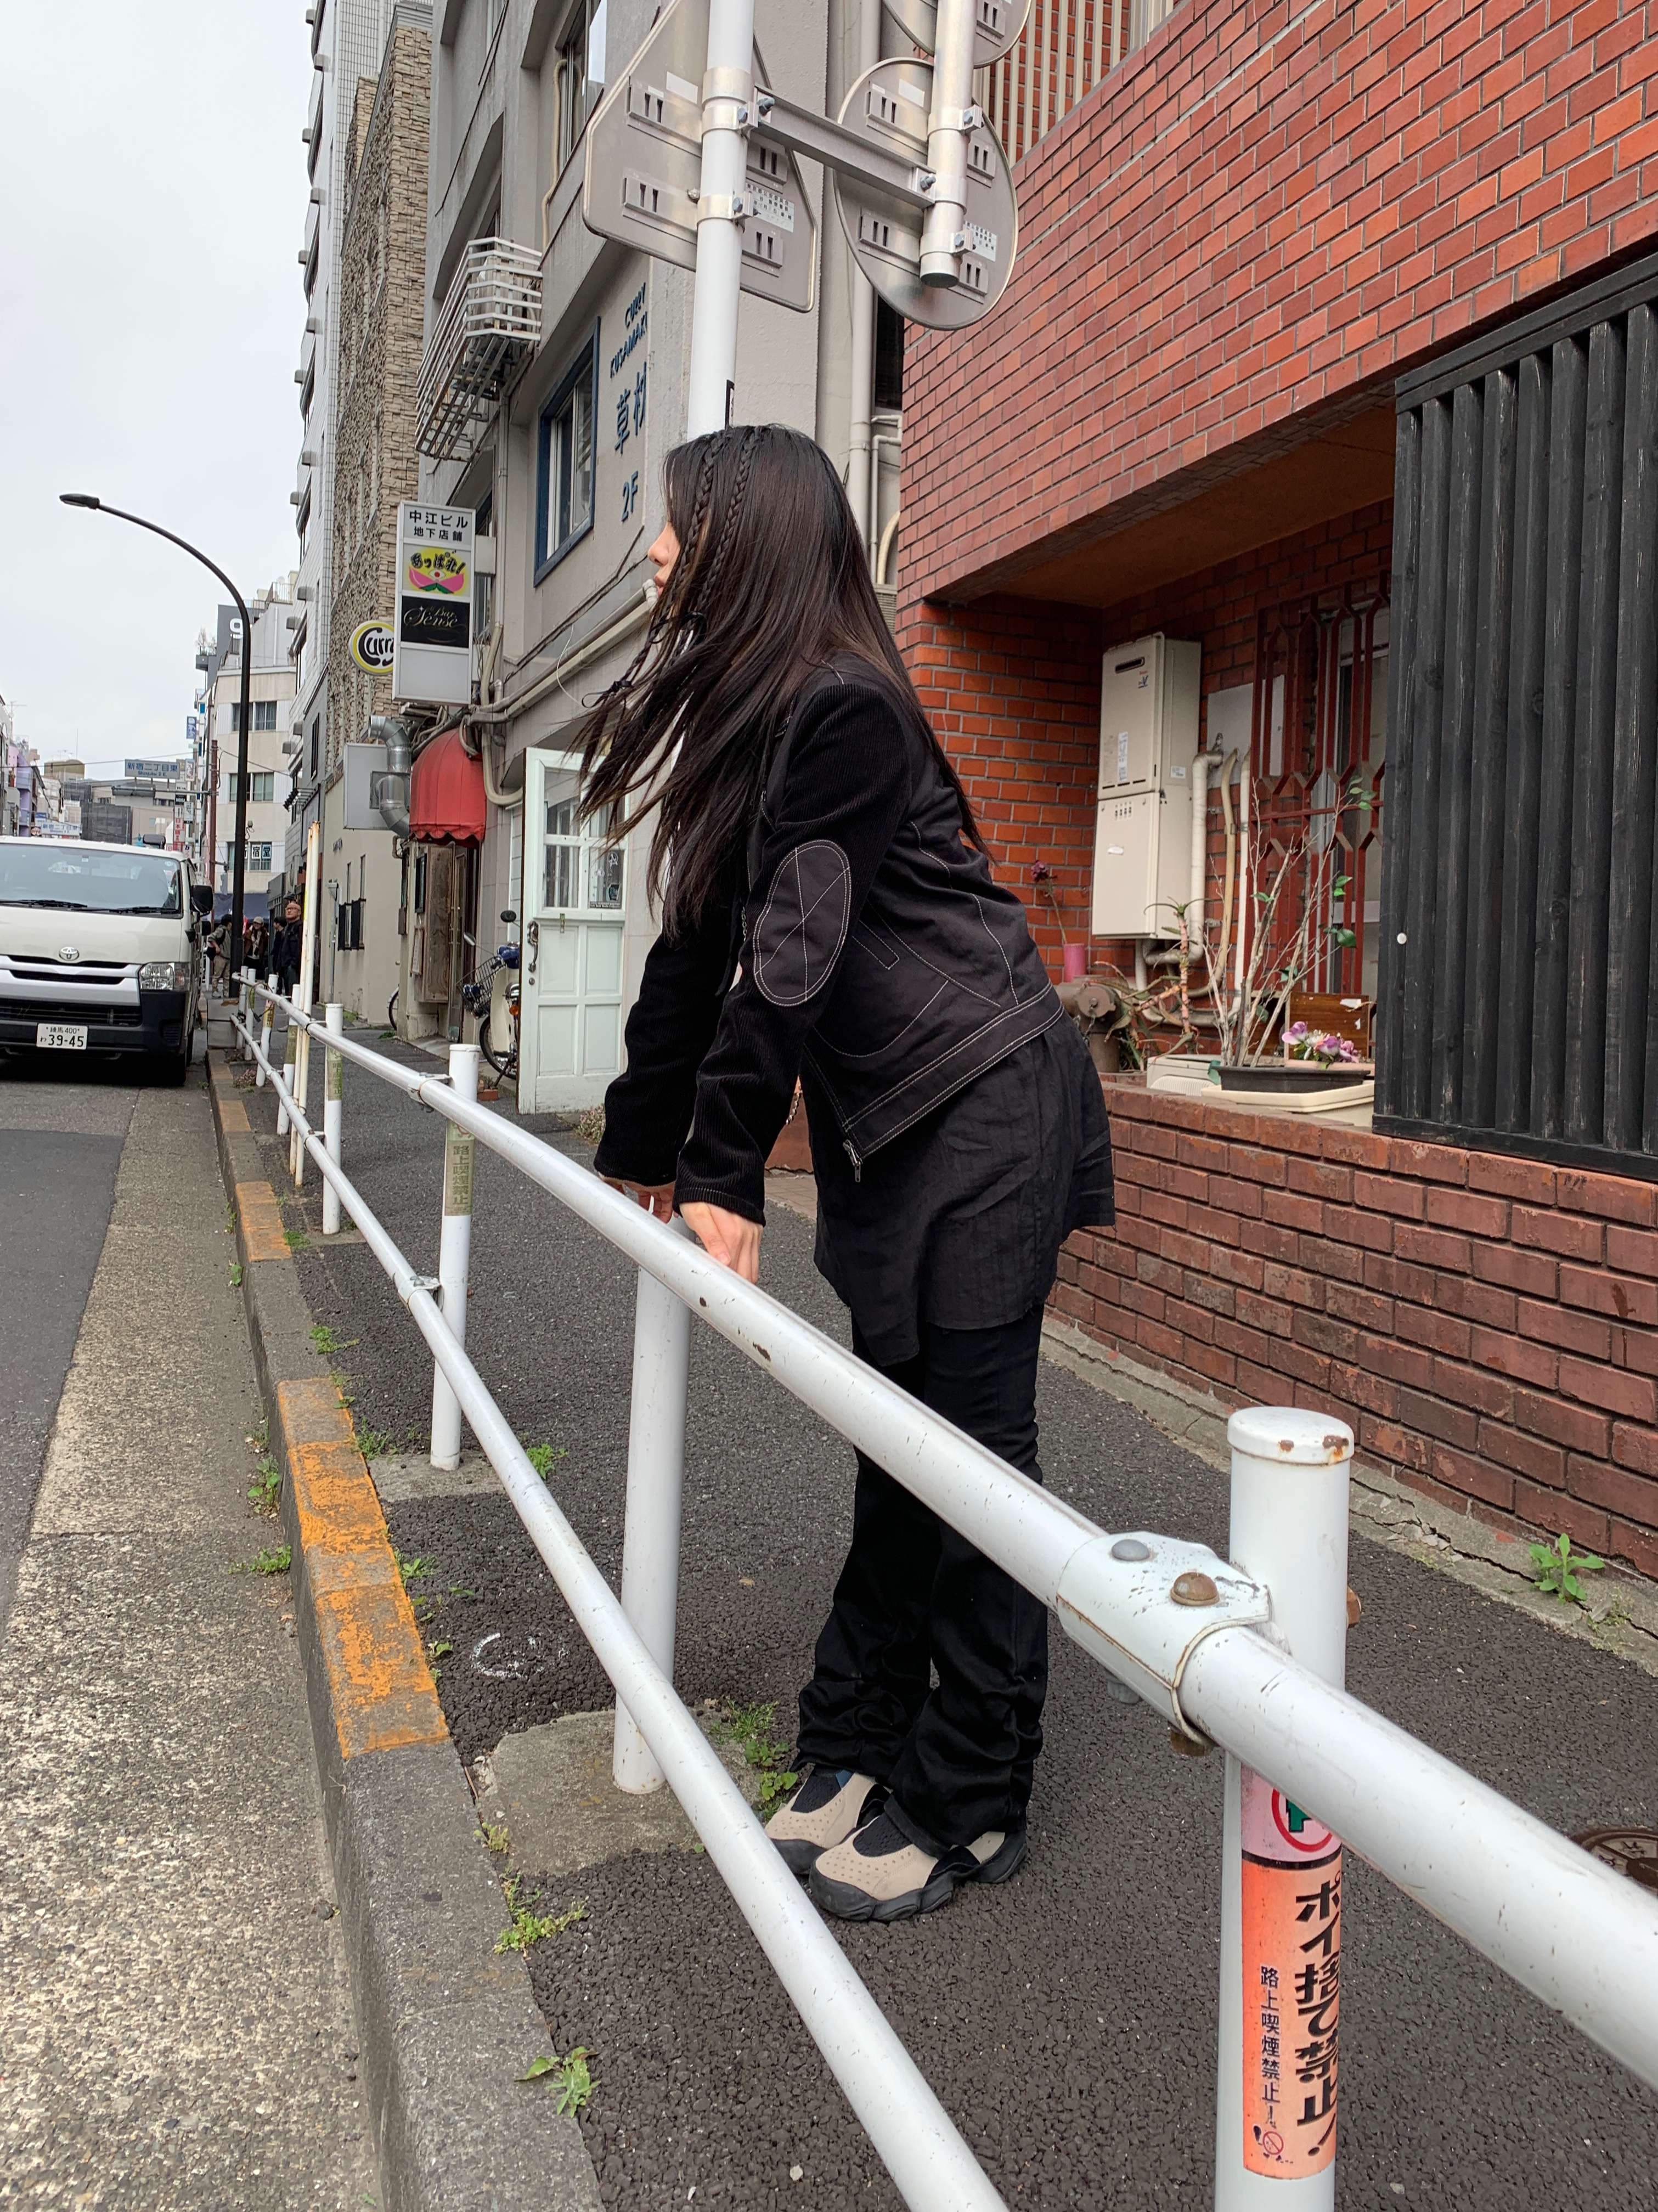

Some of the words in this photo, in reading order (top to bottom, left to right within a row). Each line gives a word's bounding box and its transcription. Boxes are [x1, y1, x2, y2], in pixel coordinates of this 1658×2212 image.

[625, 282, 646, 329] CURRY
[621, 470, 639, 522] 2F
[409, 510, 468, 528] 中江ビル
[414, 526, 463, 541] 地下店舗
[403, 606, 458, 628] Sense
[127, 762, 178, 772] 新宿二丁目東
[48, 1034, 84, 1047] 39-45
[453, 1145, 470, 1205] 路上喫煙禁止
[1261, 1966, 1282, 2128] 路上喫煙禁止!
